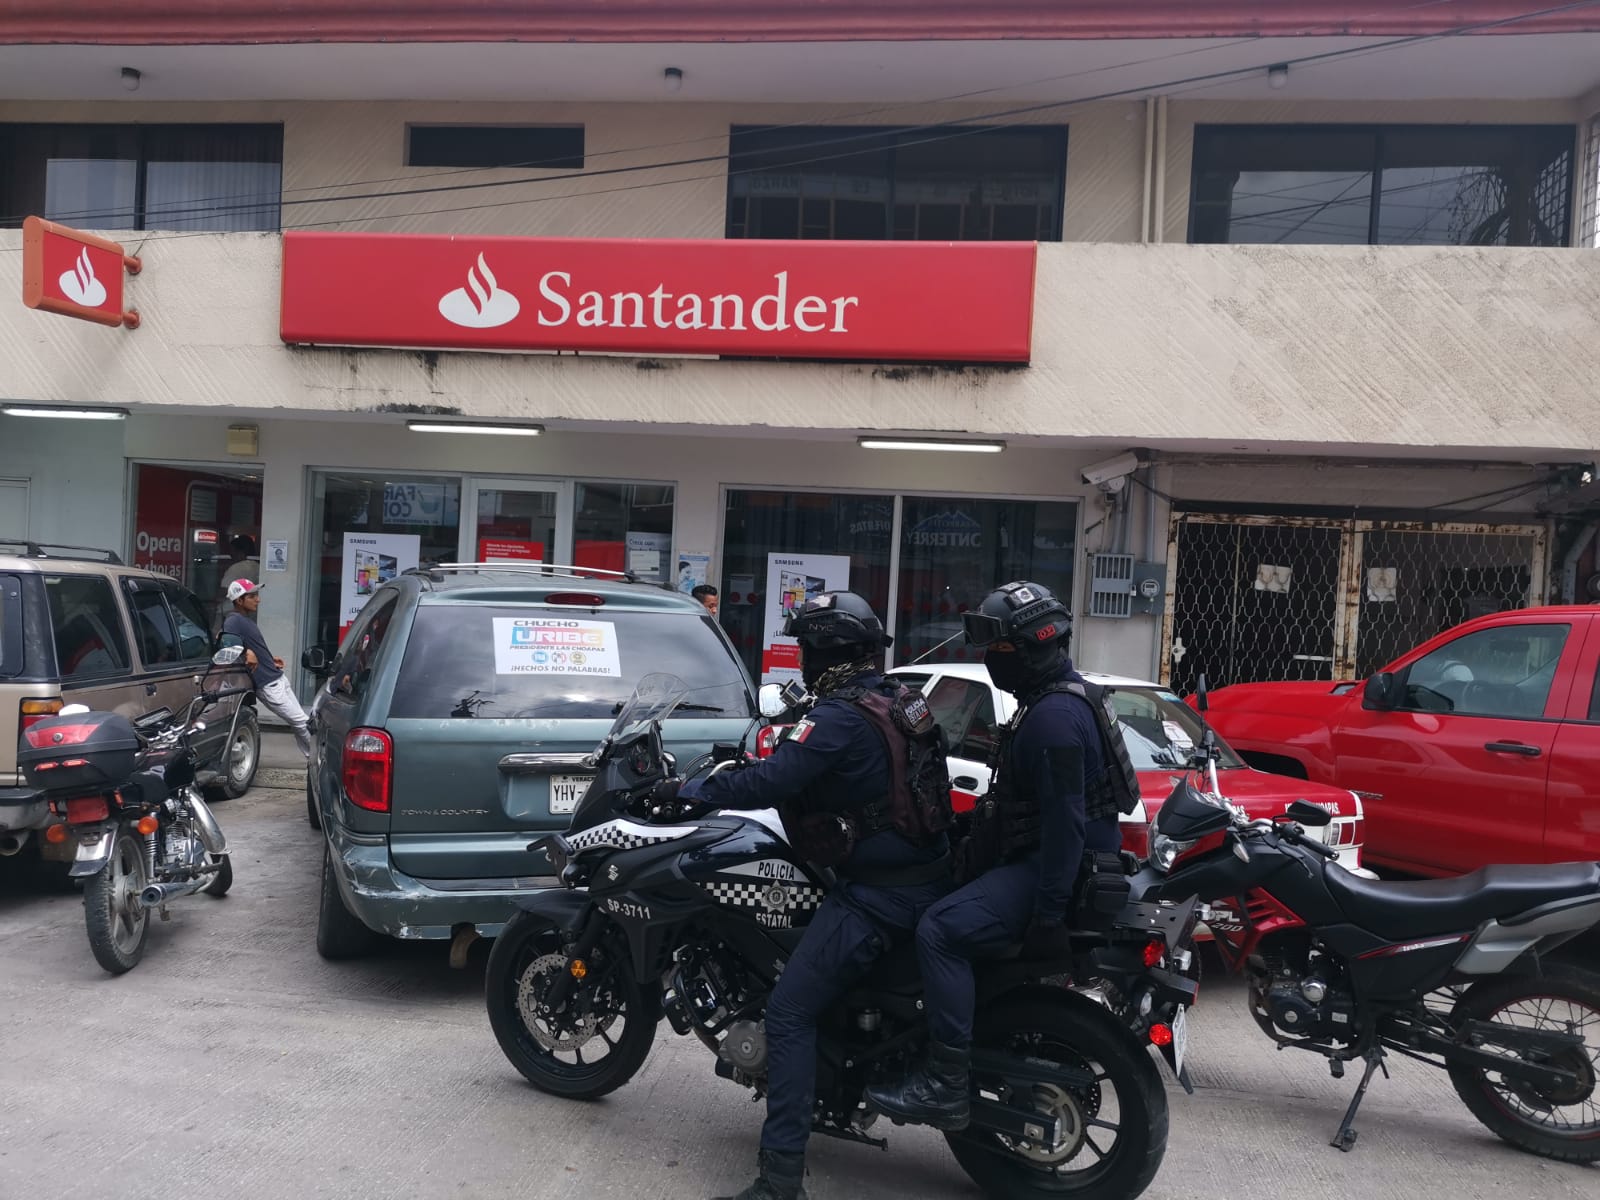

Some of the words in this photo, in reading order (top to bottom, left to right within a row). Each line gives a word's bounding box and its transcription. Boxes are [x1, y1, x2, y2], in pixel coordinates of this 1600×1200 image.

[537, 270, 858, 334] Santander
[136, 531, 181, 557] Opera
[515, 629, 602, 644] URIBE
[567, 666, 611, 674] PALABRAS!
[553, 784, 588, 801] YHV-
[758, 862, 795, 880] POLICIA
[607, 898, 651, 920] SP-3711
[755, 912, 793, 929] ESTATAL
[1211, 923, 1244, 931] 200
